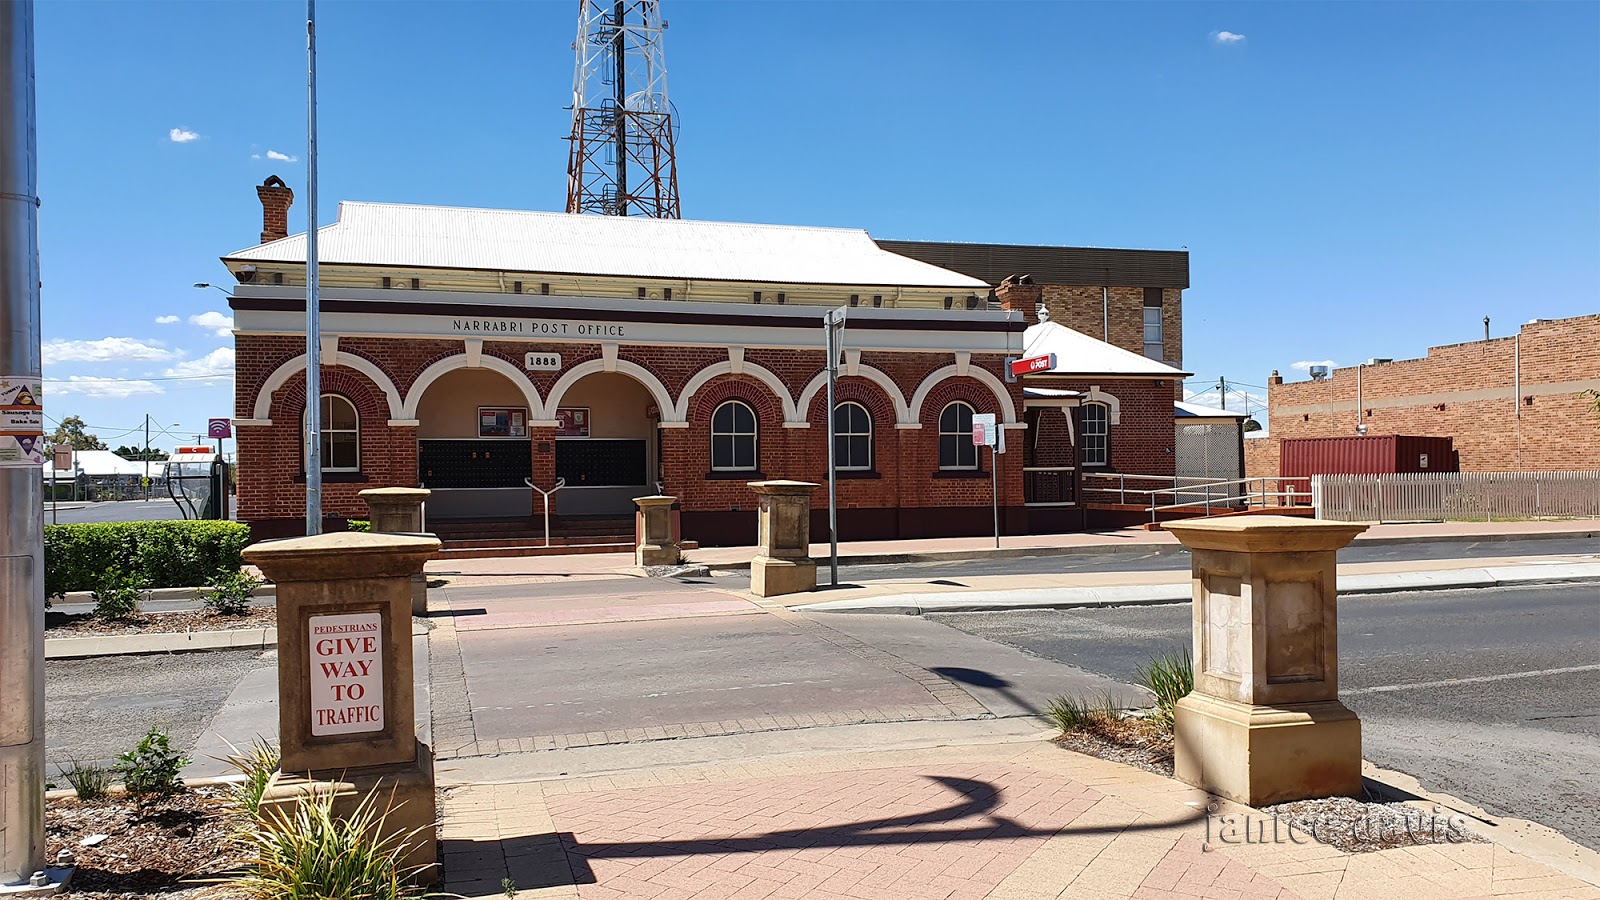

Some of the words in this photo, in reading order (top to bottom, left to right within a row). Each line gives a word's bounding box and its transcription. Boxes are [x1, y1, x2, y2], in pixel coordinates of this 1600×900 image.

[453, 320, 523, 332] NARRABRI
[531, 322, 569, 334] POST
[578, 325, 625, 336] OFFICE
[529, 357, 557, 366] 1888
[1035, 359, 1047, 369] POST
[314, 623, 378, 634] PEDESTRIANS
[316, 636, 377, 656] GIVE
[320, 660, 373, 678] WAY
[330, 683, 365, 701] TO
[316, 705, 380, 726] TRAFFIC
